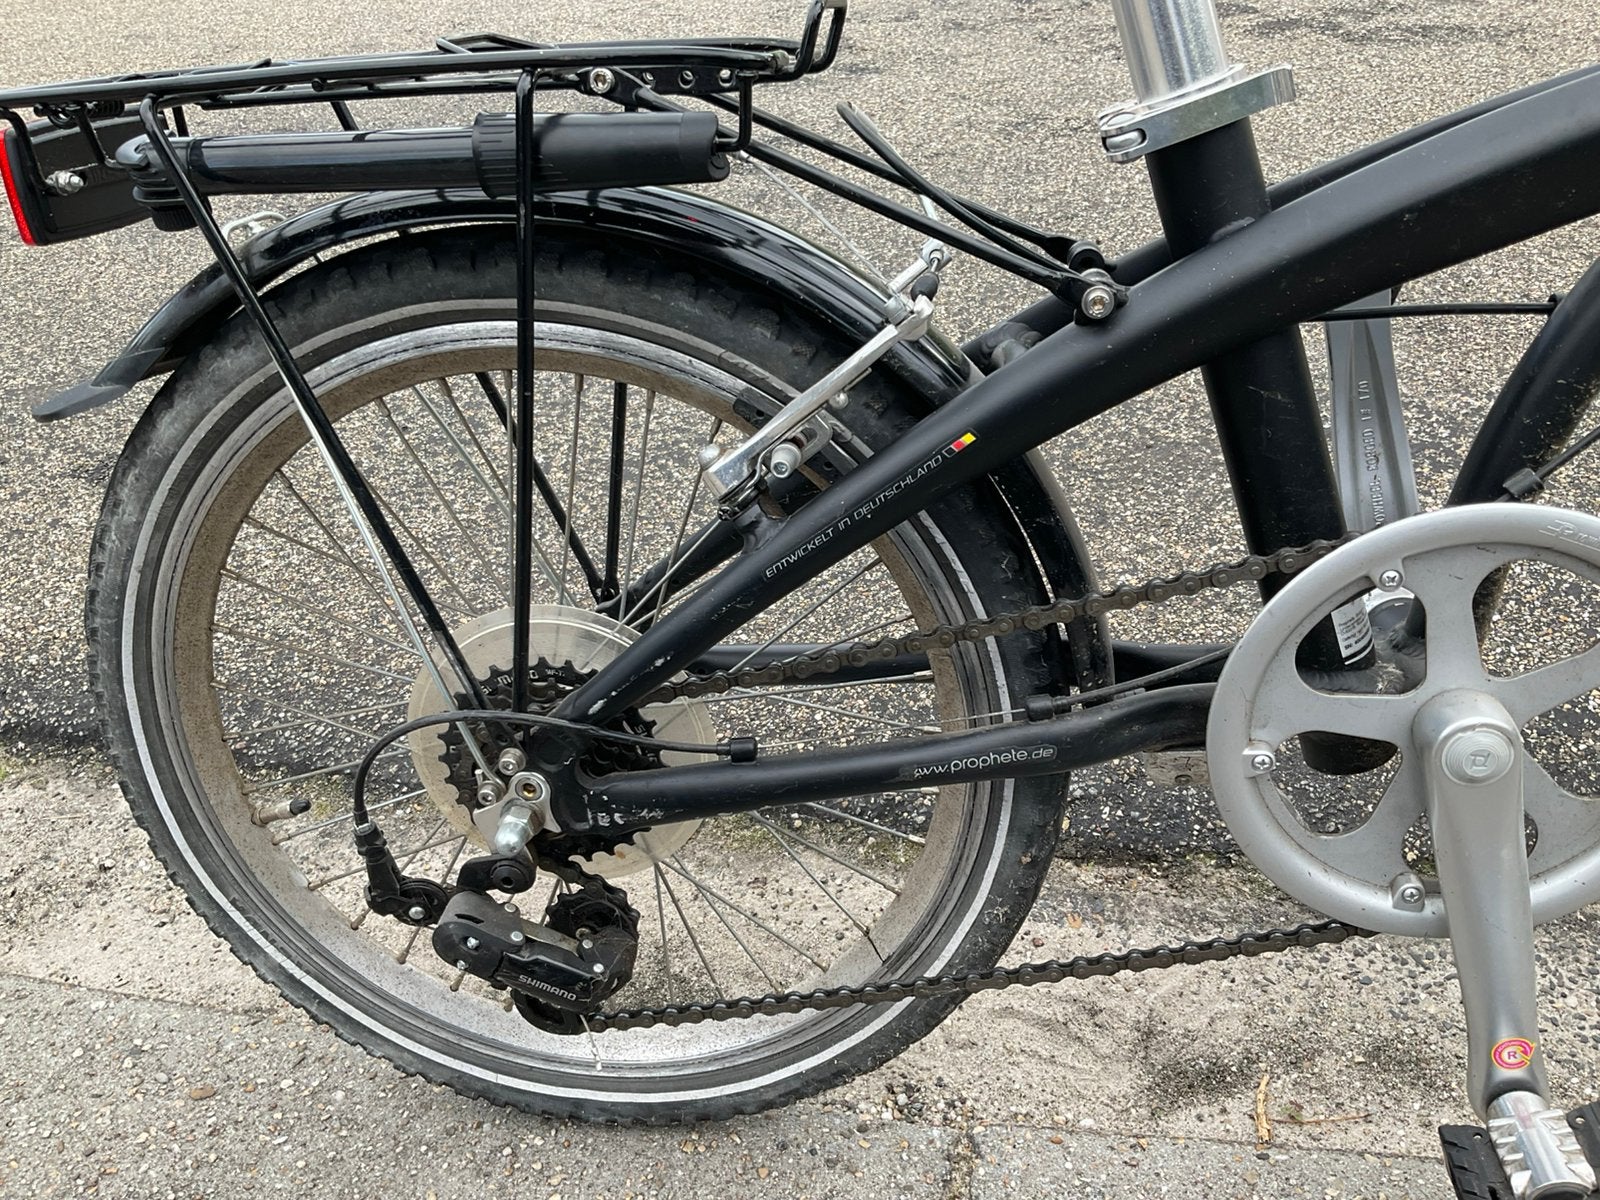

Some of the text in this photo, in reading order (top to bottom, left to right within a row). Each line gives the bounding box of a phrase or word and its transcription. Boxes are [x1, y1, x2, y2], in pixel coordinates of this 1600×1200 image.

[1358, 380, 1370, 400] 170
[766, 455, 943, 578] ENTWICKELT IN DEUTSCHLAND
[518, 974, 577, 1001] SHIMANO
